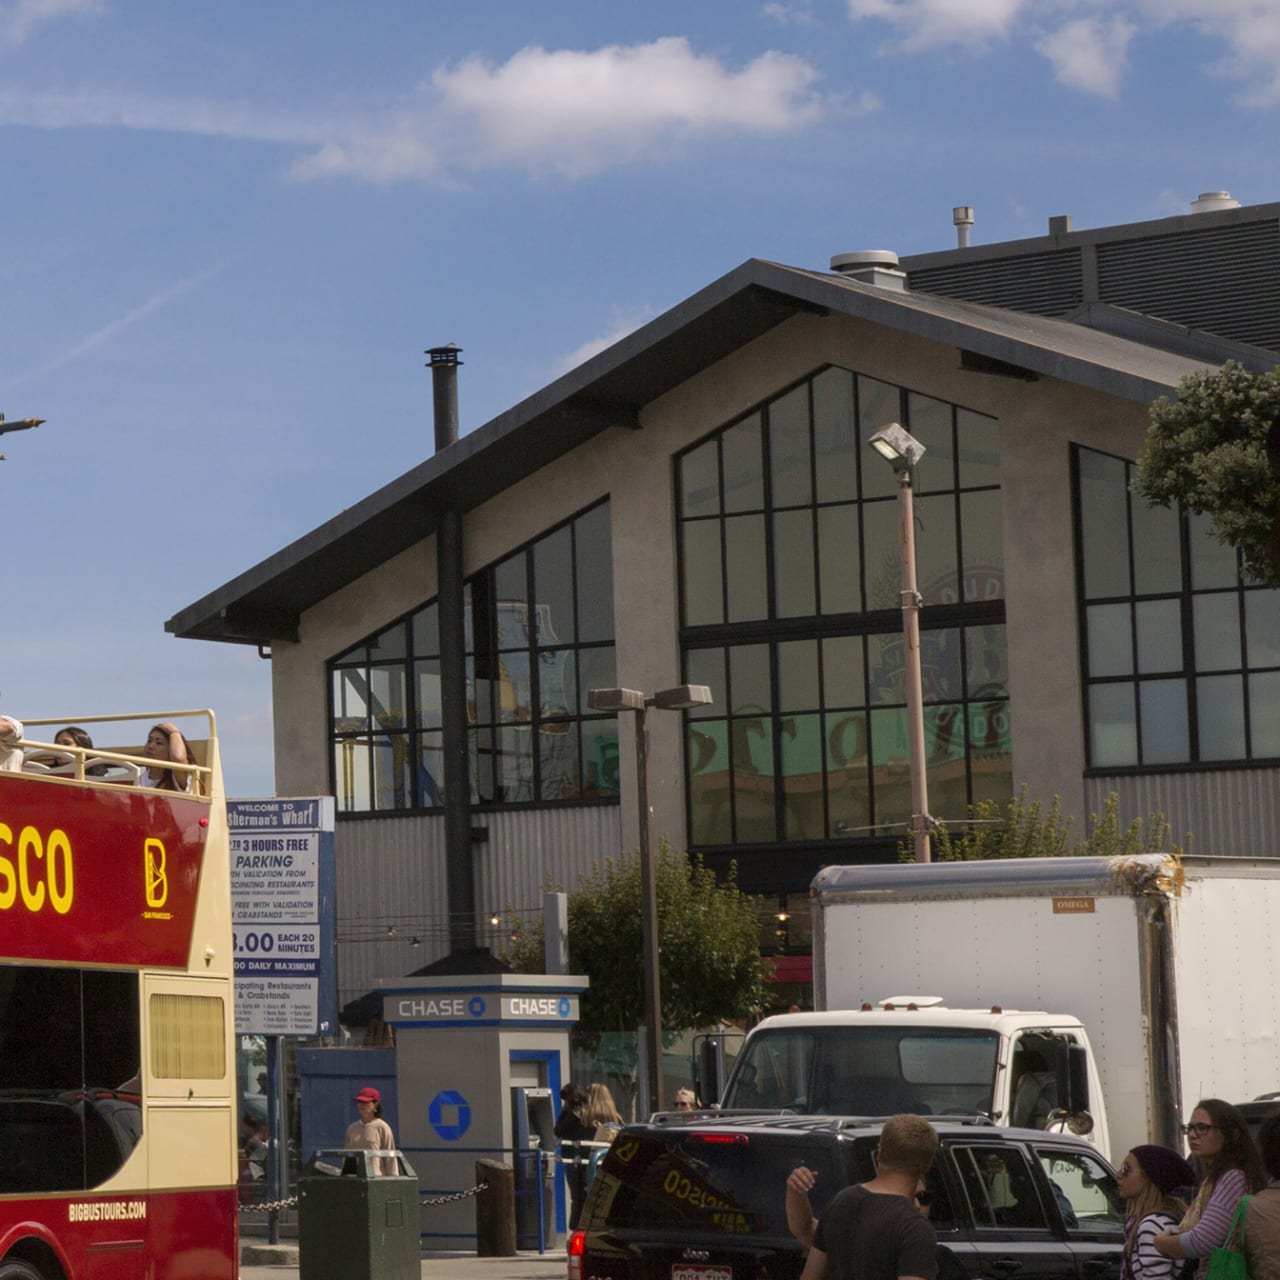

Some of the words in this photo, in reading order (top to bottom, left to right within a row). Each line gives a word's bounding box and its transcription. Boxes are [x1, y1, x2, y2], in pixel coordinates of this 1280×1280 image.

[237, 804, 279, 812] WELCOME
[282, 803, 314, 825] Wharf
[233, 840, 241, 849] TO
[243, 839, 250, 852] 3
[251, 839, 284, 852] HOURS
[286, 838, 309, 851] FREE
[236, 855, 293, 869] PARKING
[267, 880, 315, 888] RESTAURANTS
[234, 901, 250, 909] FREE
[273, 901, 314, 909] VALIDATION
[278, 933, 300, 942] EACH
[302, 933, 315, 942] 20
[277, 944, 315, 953] MINUTES
[248, 962, 272, 970] DAILY
[274, 962, 316, 971] MAXIMUM
[267, 982, 312, 990] Restaurants
[247, 992, 291, 1000] Crabstands
[398, 999, 465, 1017] CHASE
[510, 998, 558, 1015] CHASE
[68, 1201, 147, 1222] BIGBUSTOURS.COM
